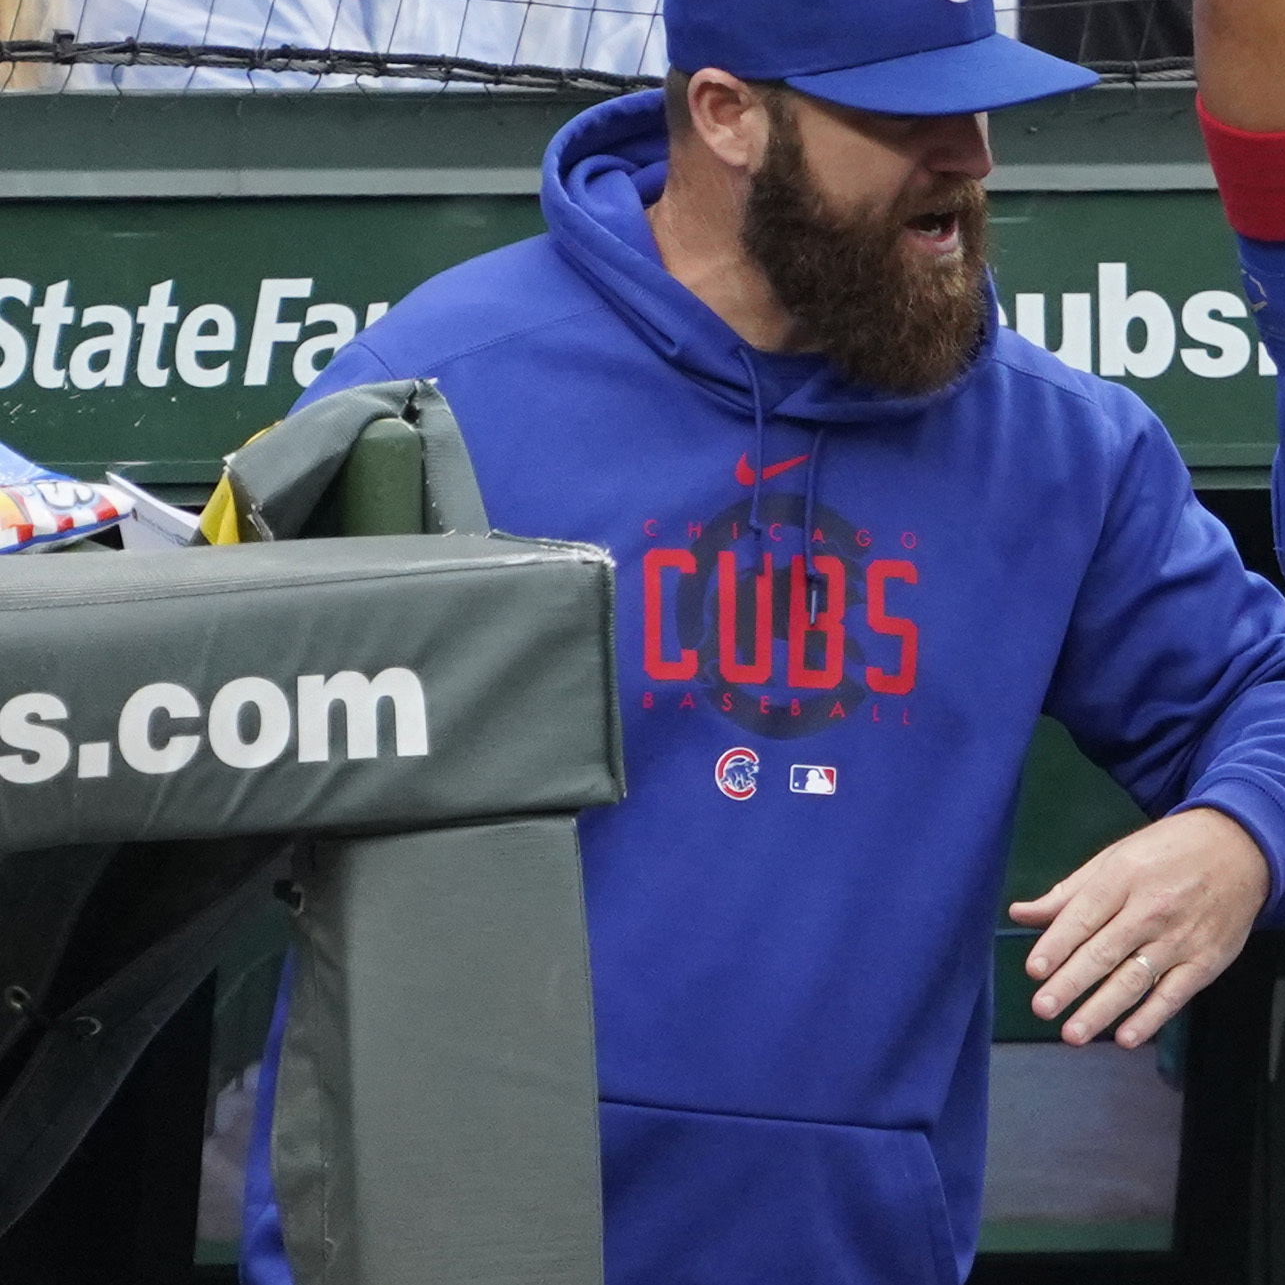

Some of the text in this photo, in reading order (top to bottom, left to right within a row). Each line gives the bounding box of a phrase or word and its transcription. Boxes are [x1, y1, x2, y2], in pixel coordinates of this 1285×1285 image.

[643, 519, 917, 549] CHICAGO
[642, 548, 919, 696] CUBS
[0, 667, 429, 784] s.com
[642, 692, 912, 726] BASEBALL
